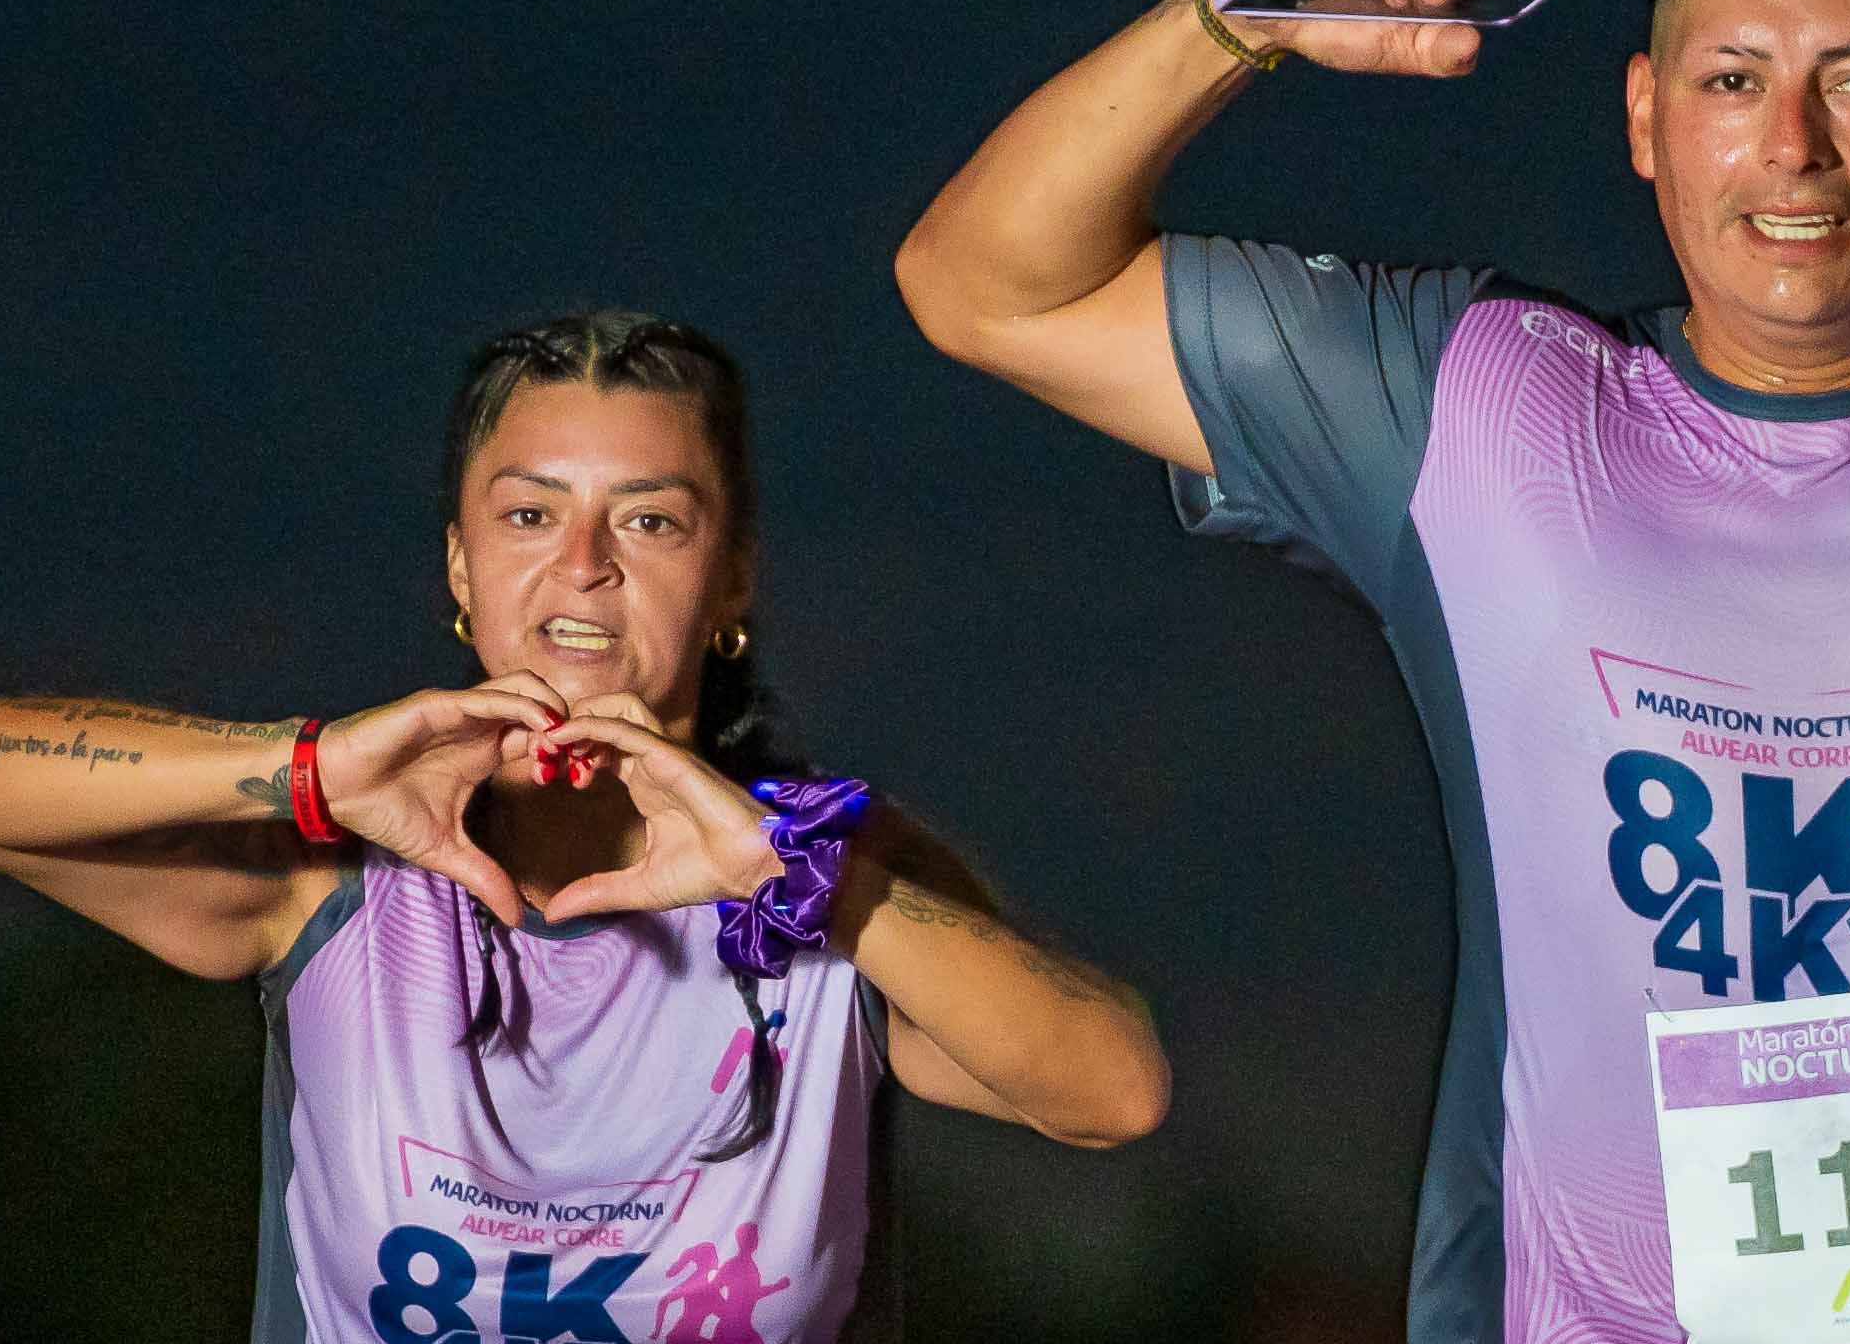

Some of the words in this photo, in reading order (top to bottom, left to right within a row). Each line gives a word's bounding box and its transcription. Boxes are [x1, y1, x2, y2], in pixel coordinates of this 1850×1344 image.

[1635, 688, 1763, 735] MARATON
[1680, 729, 1780, 767] ALVEAR
[429, 1174, 539, 1219] MARATON
[545, 1201, 666, 1223] NOCTURNA
[459, 1213, 545, 1244] ALVEAR
[553, 1227, 624, 1248] CORRE
